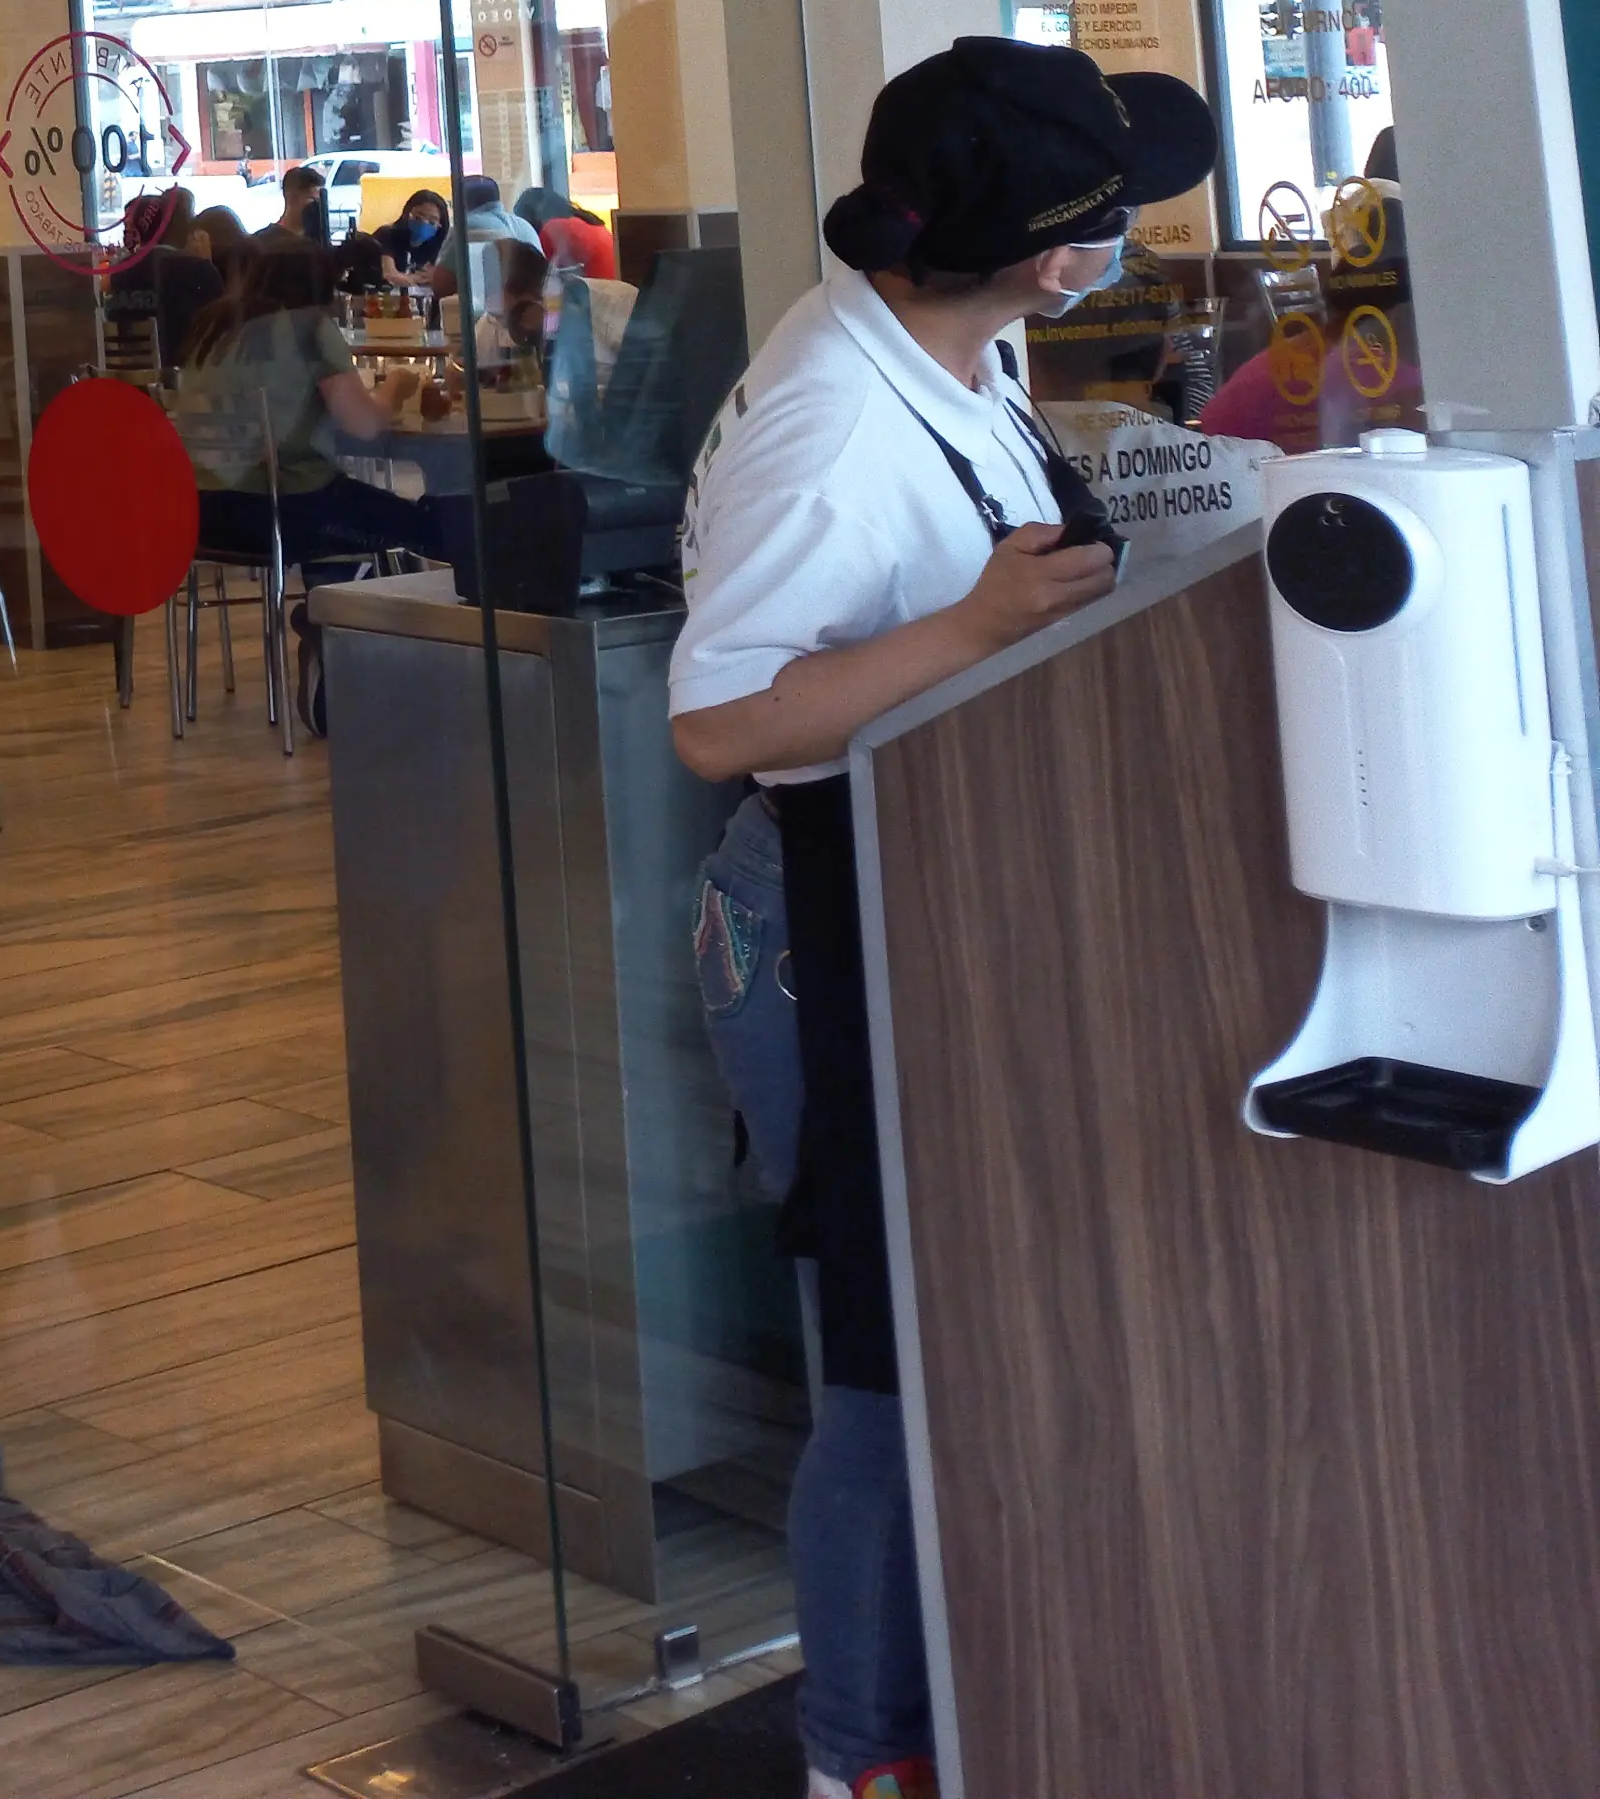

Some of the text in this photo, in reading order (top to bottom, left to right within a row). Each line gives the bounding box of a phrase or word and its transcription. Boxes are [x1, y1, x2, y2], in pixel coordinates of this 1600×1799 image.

[1100, 3, 1138, 15] IMPEDIR
[1055, 22, 1083, 32] GOE
[1084, 21, 1090, 31] Y
[1092, 21, 1142, 32] EJERCICIO
[1059, 37, 1160, 49] DEECHOS HUMANOS
[1100, 454, 1113, 481] A
[1117, 440, 1212, 480] DOMINGO
[1107, 481, 1233, 525] 23:00 HORAS
